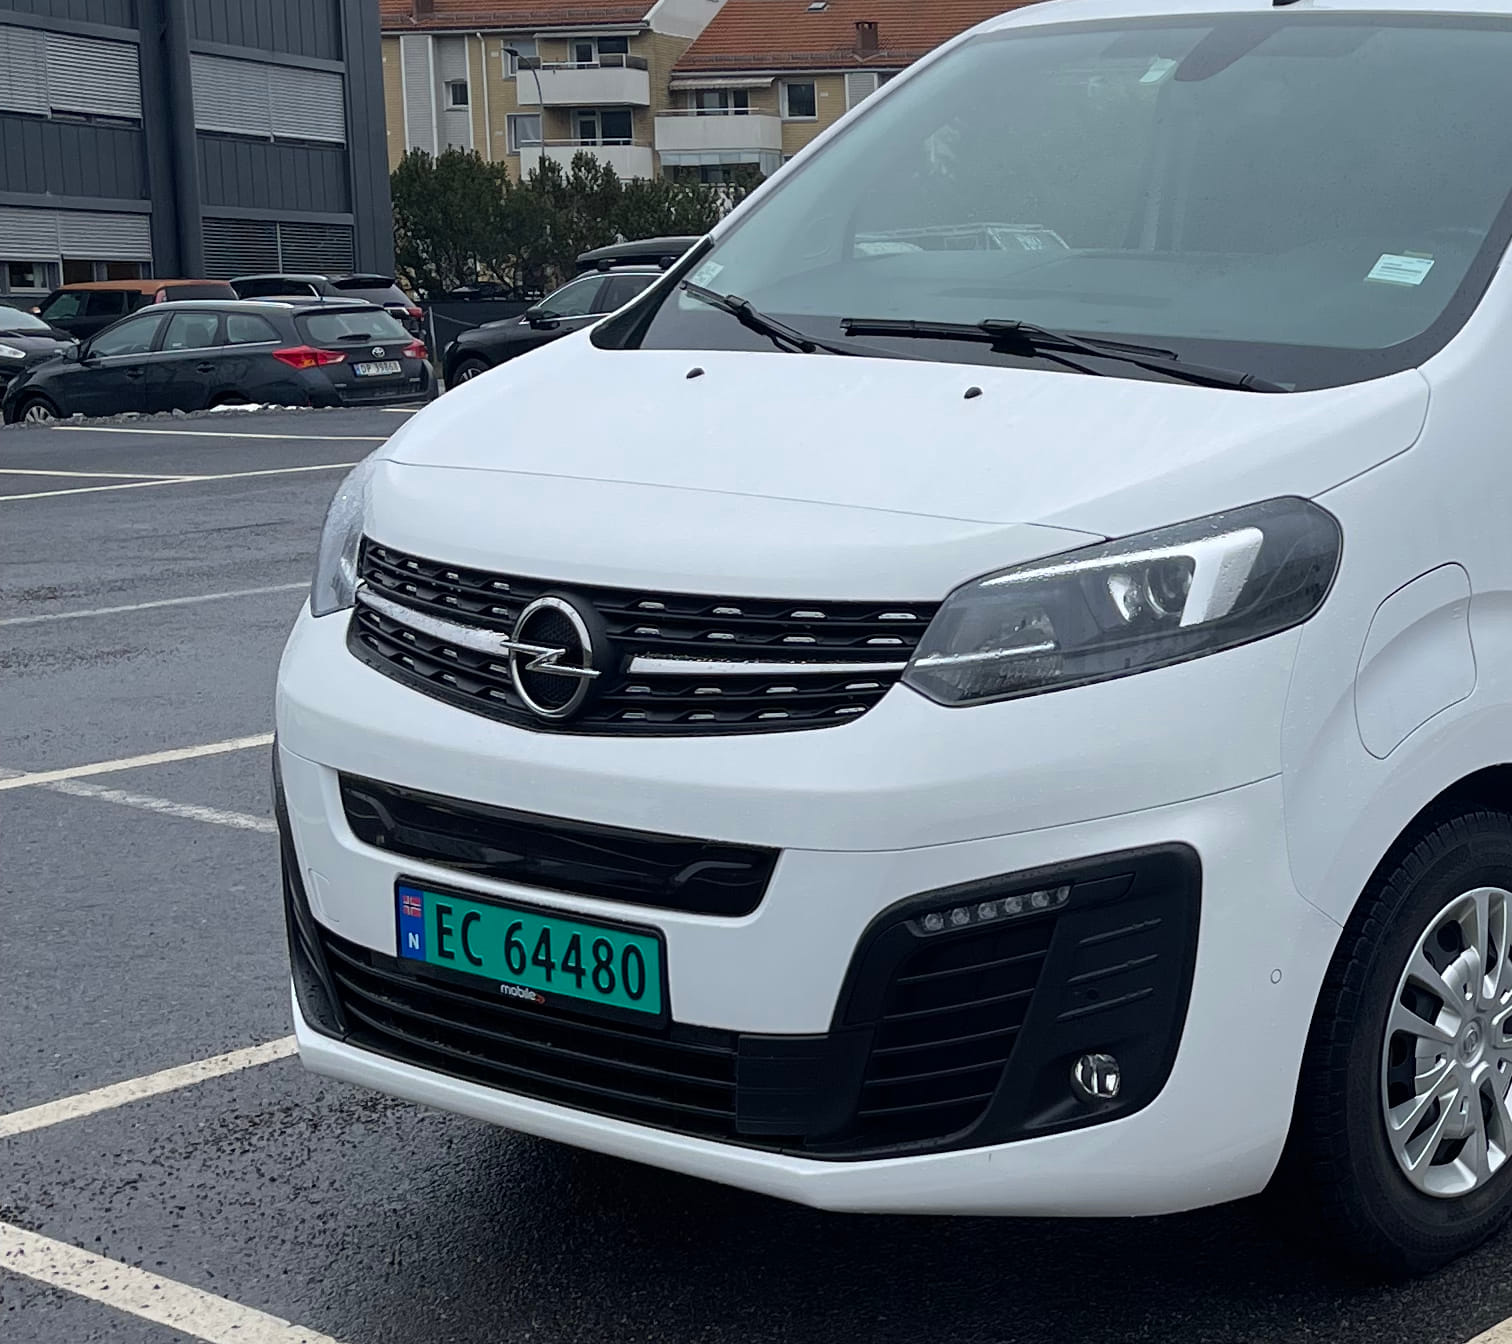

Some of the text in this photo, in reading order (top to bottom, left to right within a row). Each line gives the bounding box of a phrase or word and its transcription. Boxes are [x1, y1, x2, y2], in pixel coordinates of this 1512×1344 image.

[408, 932, 420, 950] N
[436, 904, 646, 1000] EC 64480
